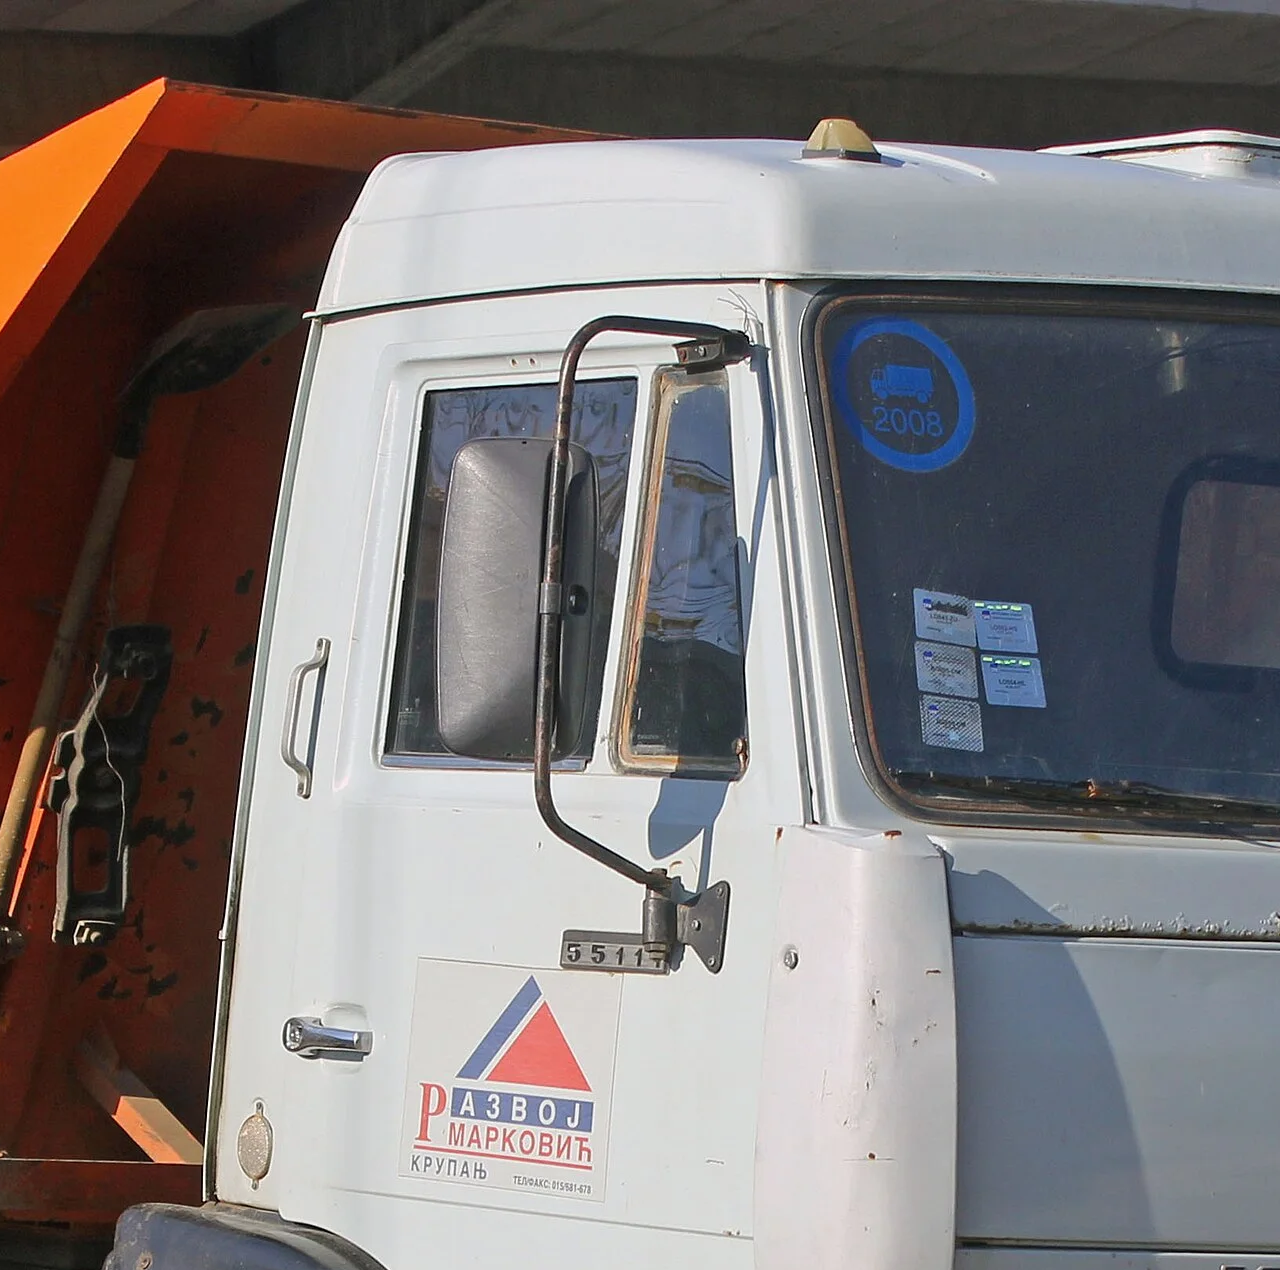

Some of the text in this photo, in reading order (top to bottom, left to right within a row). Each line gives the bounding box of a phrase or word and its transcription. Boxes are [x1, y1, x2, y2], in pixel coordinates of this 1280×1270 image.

[873, 406, 944, 438] 2008
[415, 1082, 581, 1142] РАЗВОЈ
[447, 1121, 593, 1163] МАРКОВИЋ
[410, 1154, 488, 1180] КРУПАЊ
